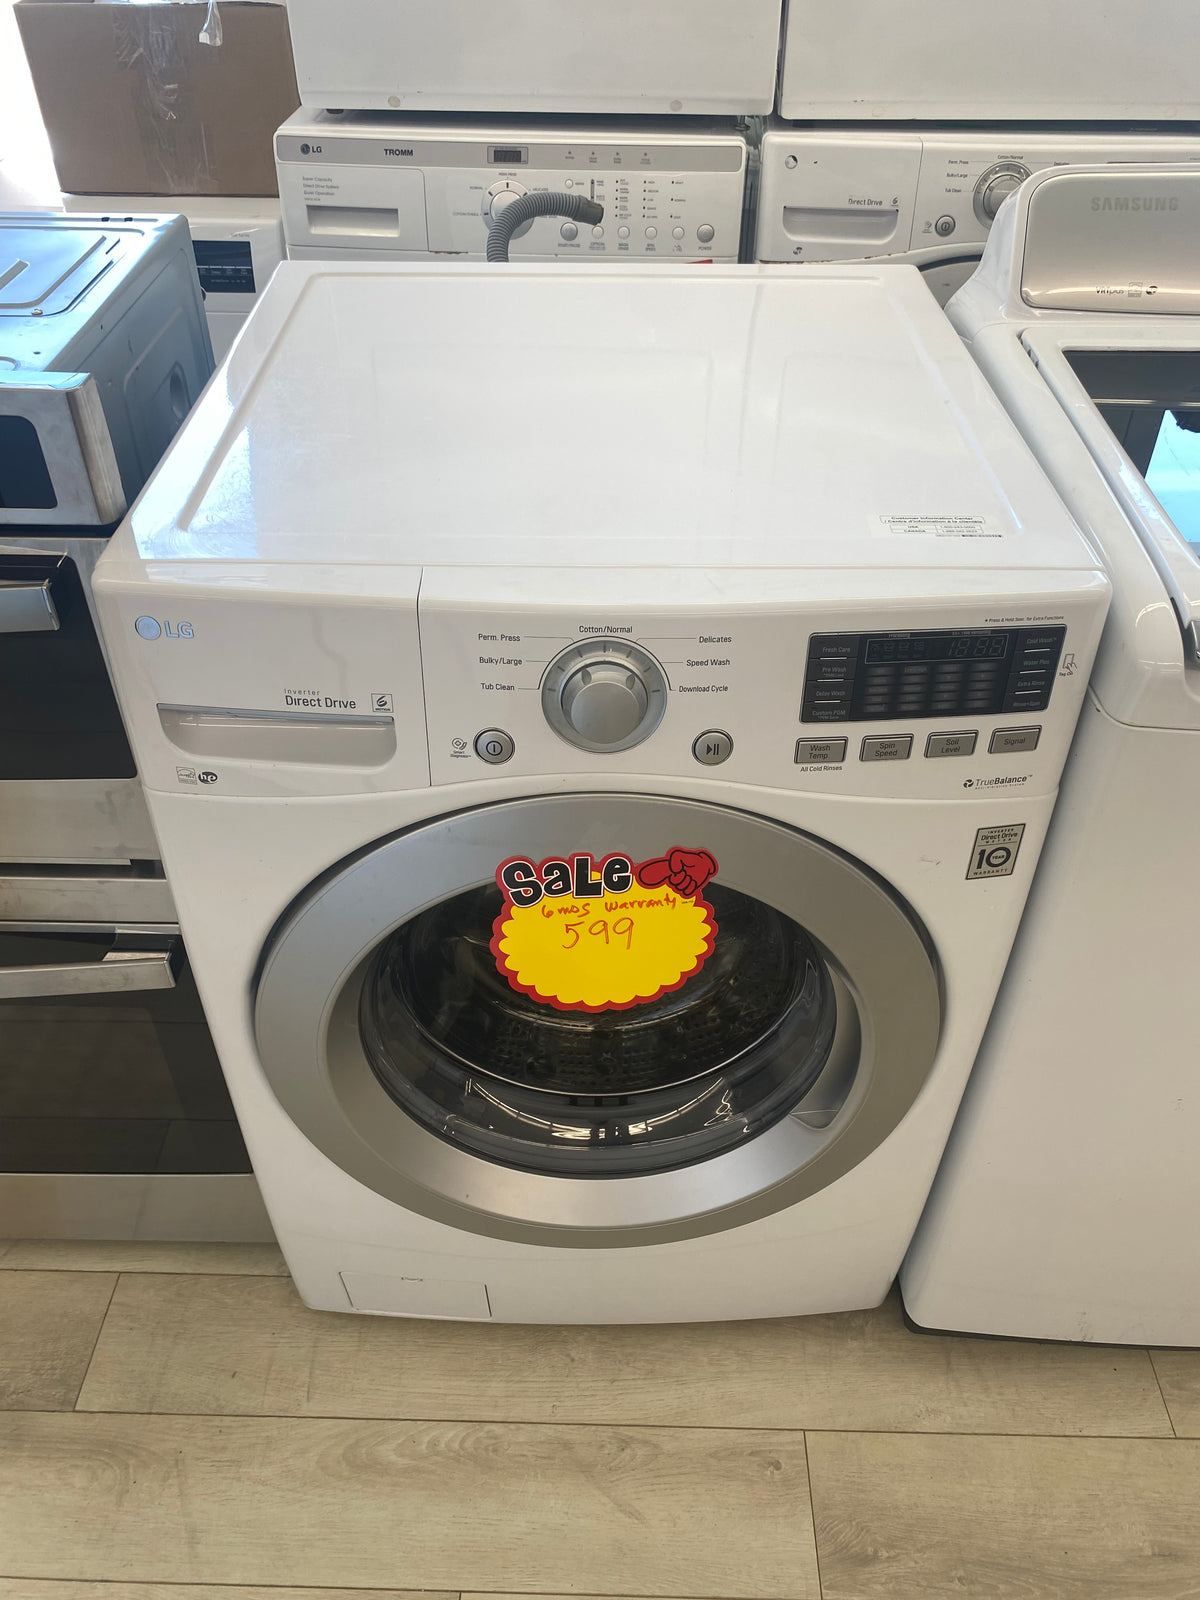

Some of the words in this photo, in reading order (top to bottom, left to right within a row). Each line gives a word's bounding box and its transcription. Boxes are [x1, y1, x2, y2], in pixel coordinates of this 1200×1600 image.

[383, 148, 414, 157] TROMM
[848, 198, 867, 206] Direct
[867, 198, 883, 206] Drive
[1091, 196, 1180, 212] SAMSUNG
[164, 620, 194, 639] LG
[579, 625, 633, 634] Cotton/Normal
[478, 633, 499, 642] Perm.
[500, 634, 521, 642] Press
[698, 635, 732, 643] Delicates
[479, 656, 523, 667] Bulky/Large
[686, 658, 708, 668] Speed
[709, 658, 731, 667] Wash
[480, 682, 494, 691] Tub
[495, 683, 515, 691] Clean
[678, 685, 710, 693] Download
[711, 685, 729, 694] Cycle
[284, 688, 321, 696] Inverter
[285, 695, 322, 708] Direct
[324, 697, 357, 709] Drive
[879, 742, 896, 750] Spin
[945, 738, 960, 746] Soil
[1003, 737, 1026, 746] Signal
[810, 744, 831, 752] Wash
[941, 746, 960, 754] Level
[808, 752, 829, 760] Temp
[875, 749, 898, 757] Speed
[980, 833, 1001, 841] Direct
[976, 846, 1012, 870] 10
[973, 868, 1009, 876] WARRANTY
[541, 904, 554, 919] 6
[562, 917, 635, 950] 599
